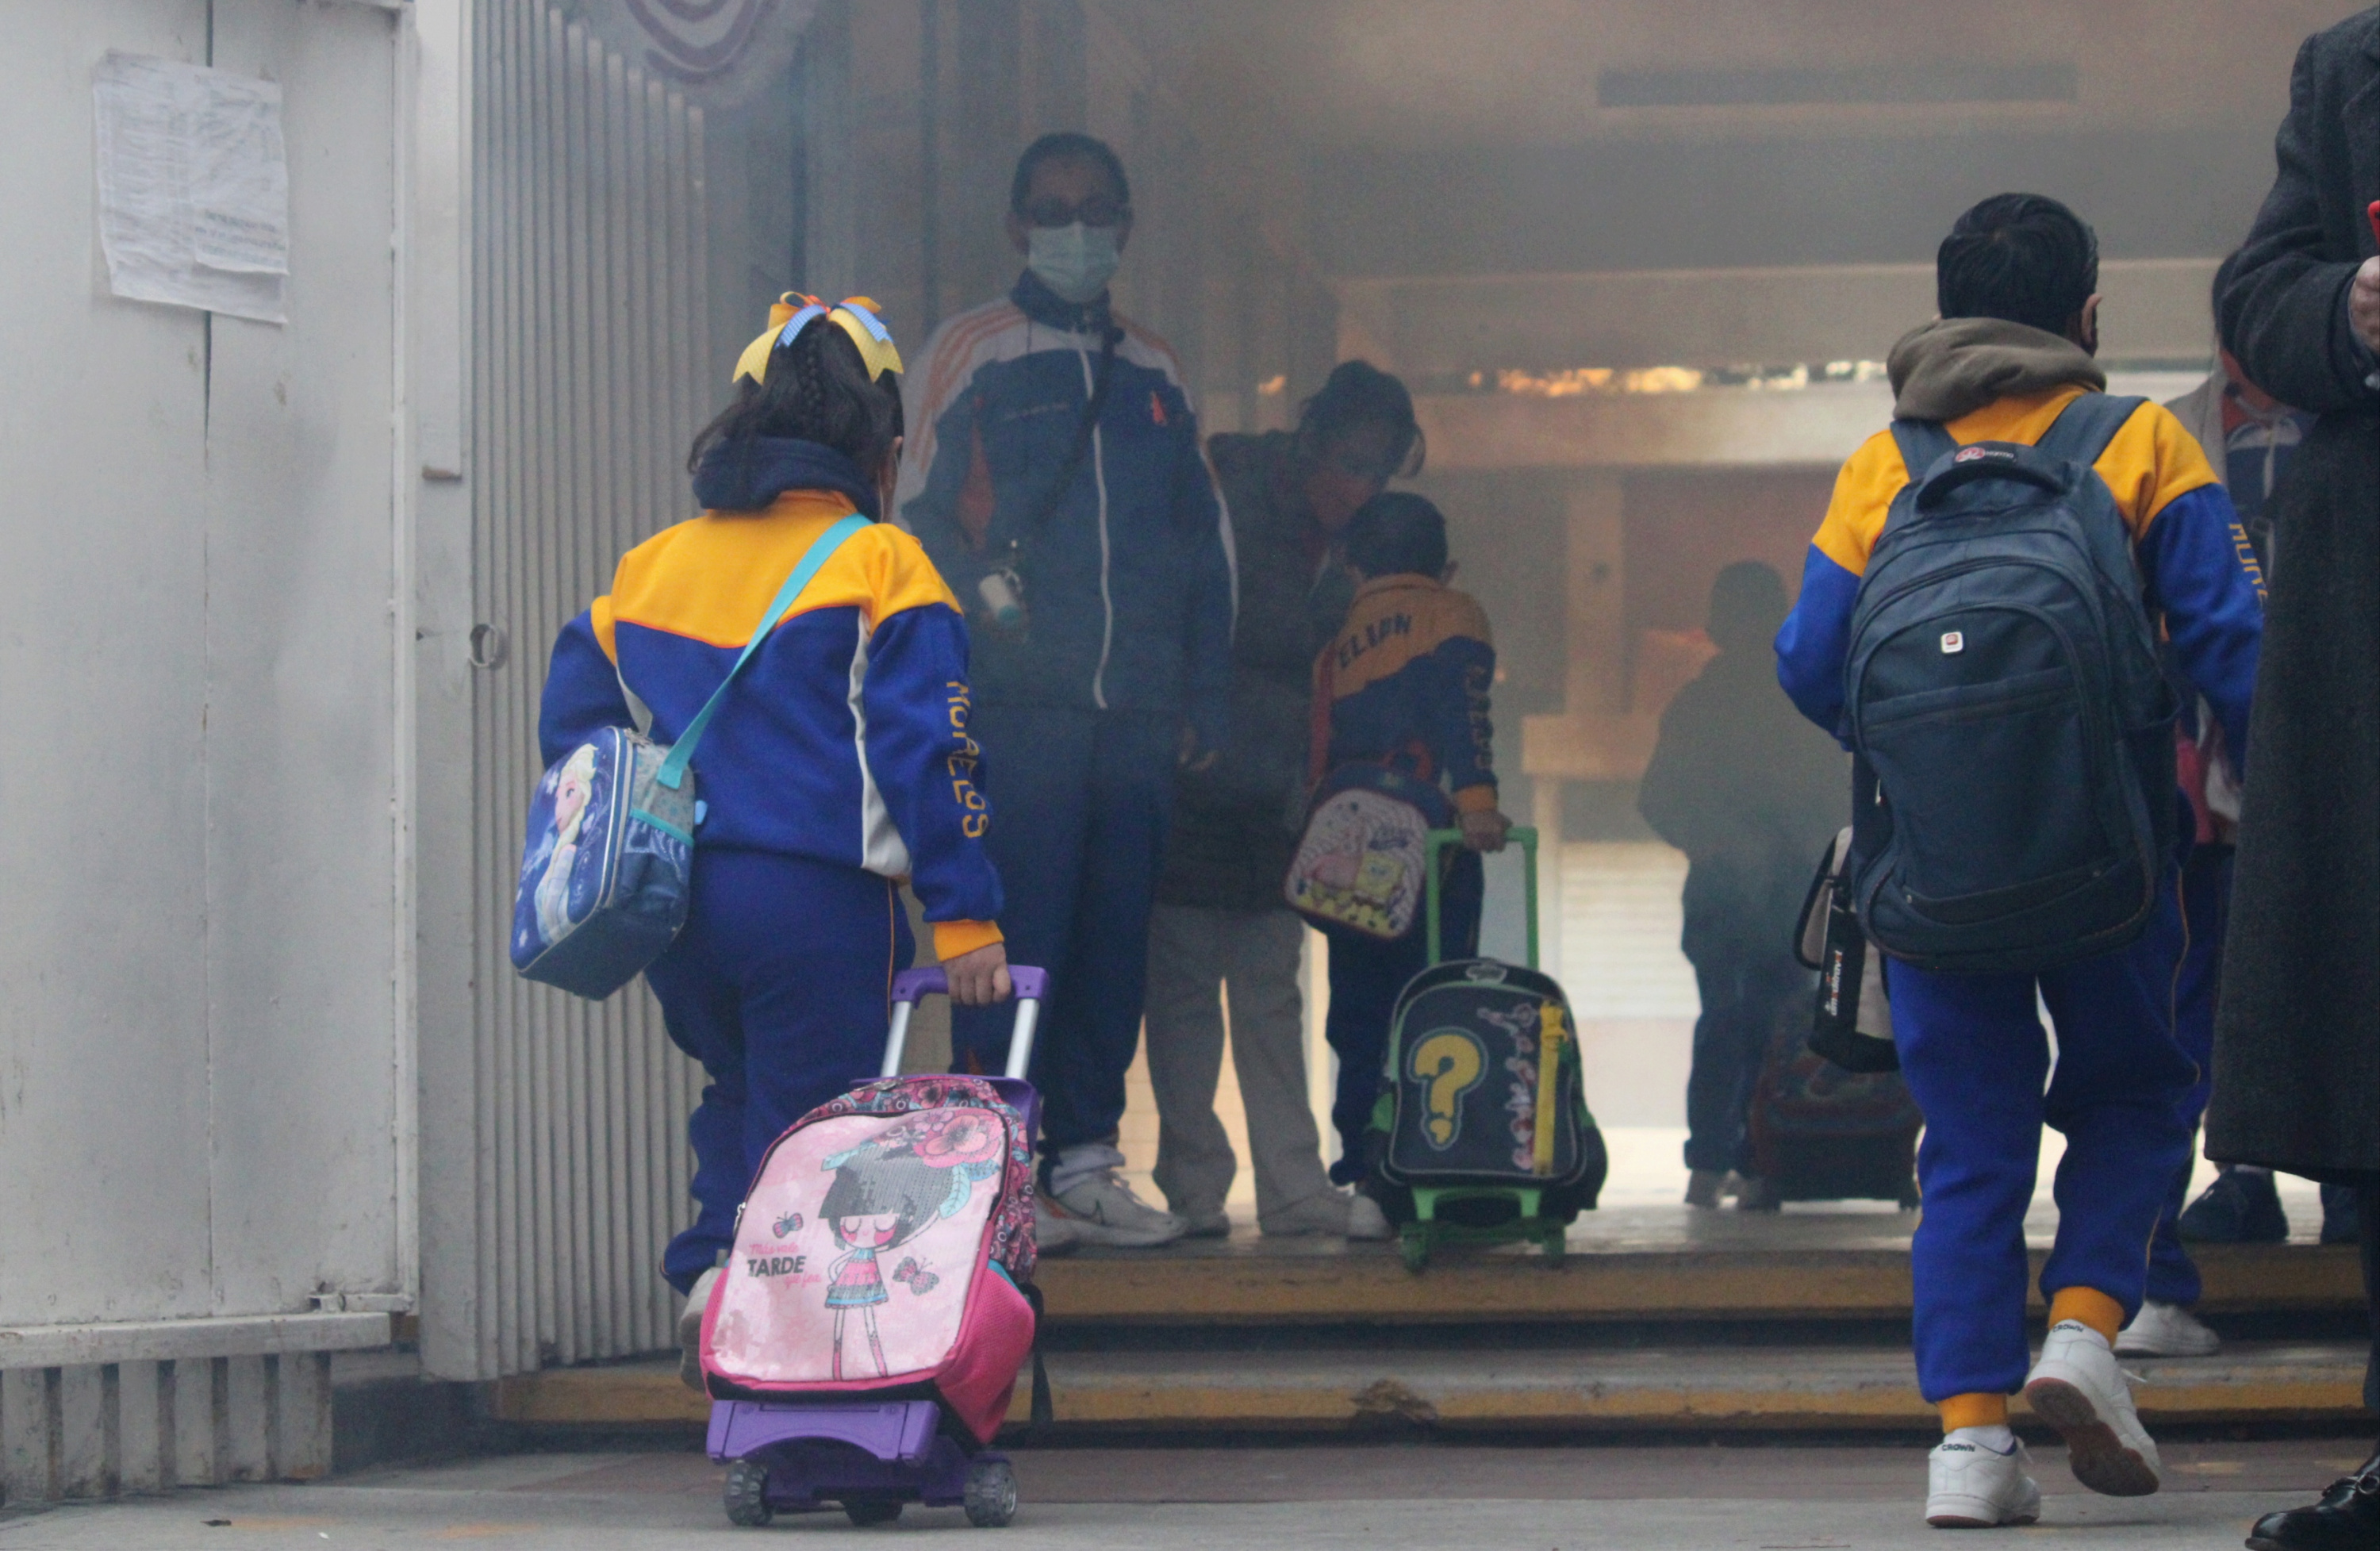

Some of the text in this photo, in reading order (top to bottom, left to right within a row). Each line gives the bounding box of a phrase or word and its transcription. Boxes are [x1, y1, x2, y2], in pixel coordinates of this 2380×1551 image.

[946, 681, 988, 839] MORELOS
[747, 1256, 807, 1277] TARDE
[2052, 1324, 2084, 1333] CROWN
